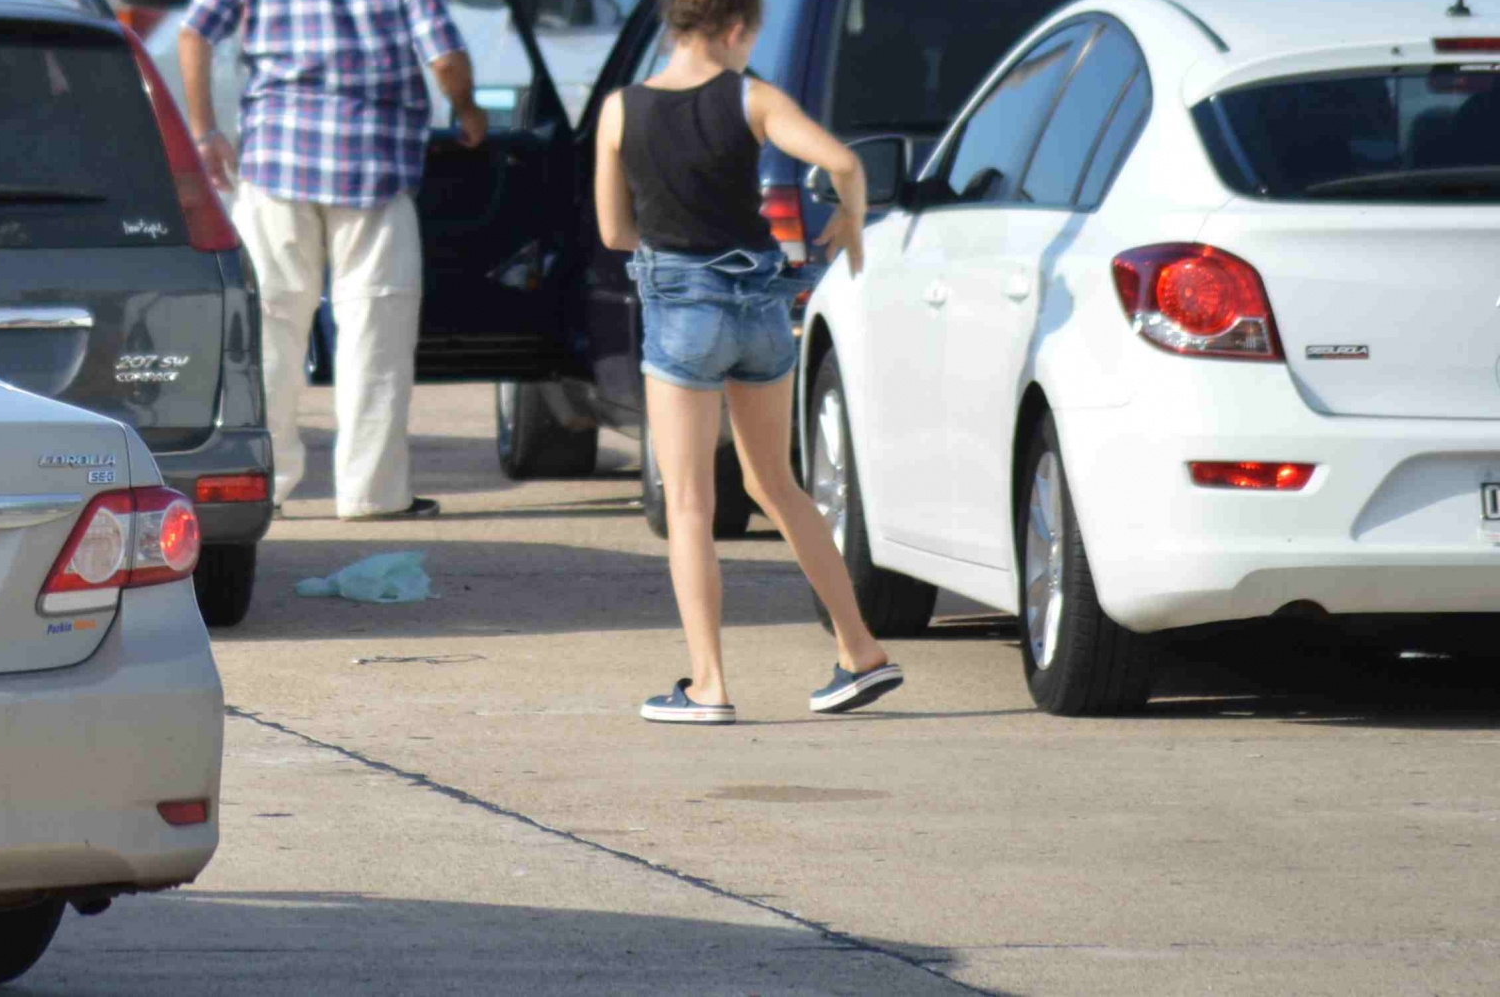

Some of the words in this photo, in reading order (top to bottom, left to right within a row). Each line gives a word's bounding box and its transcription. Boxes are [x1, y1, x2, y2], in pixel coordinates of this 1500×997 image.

[115, 355, 159, 369] 207
[160, 356, 189, 368] SW
[39, 454, 117, 467] COROLLA
[90, 472, 114, 482] SEG
